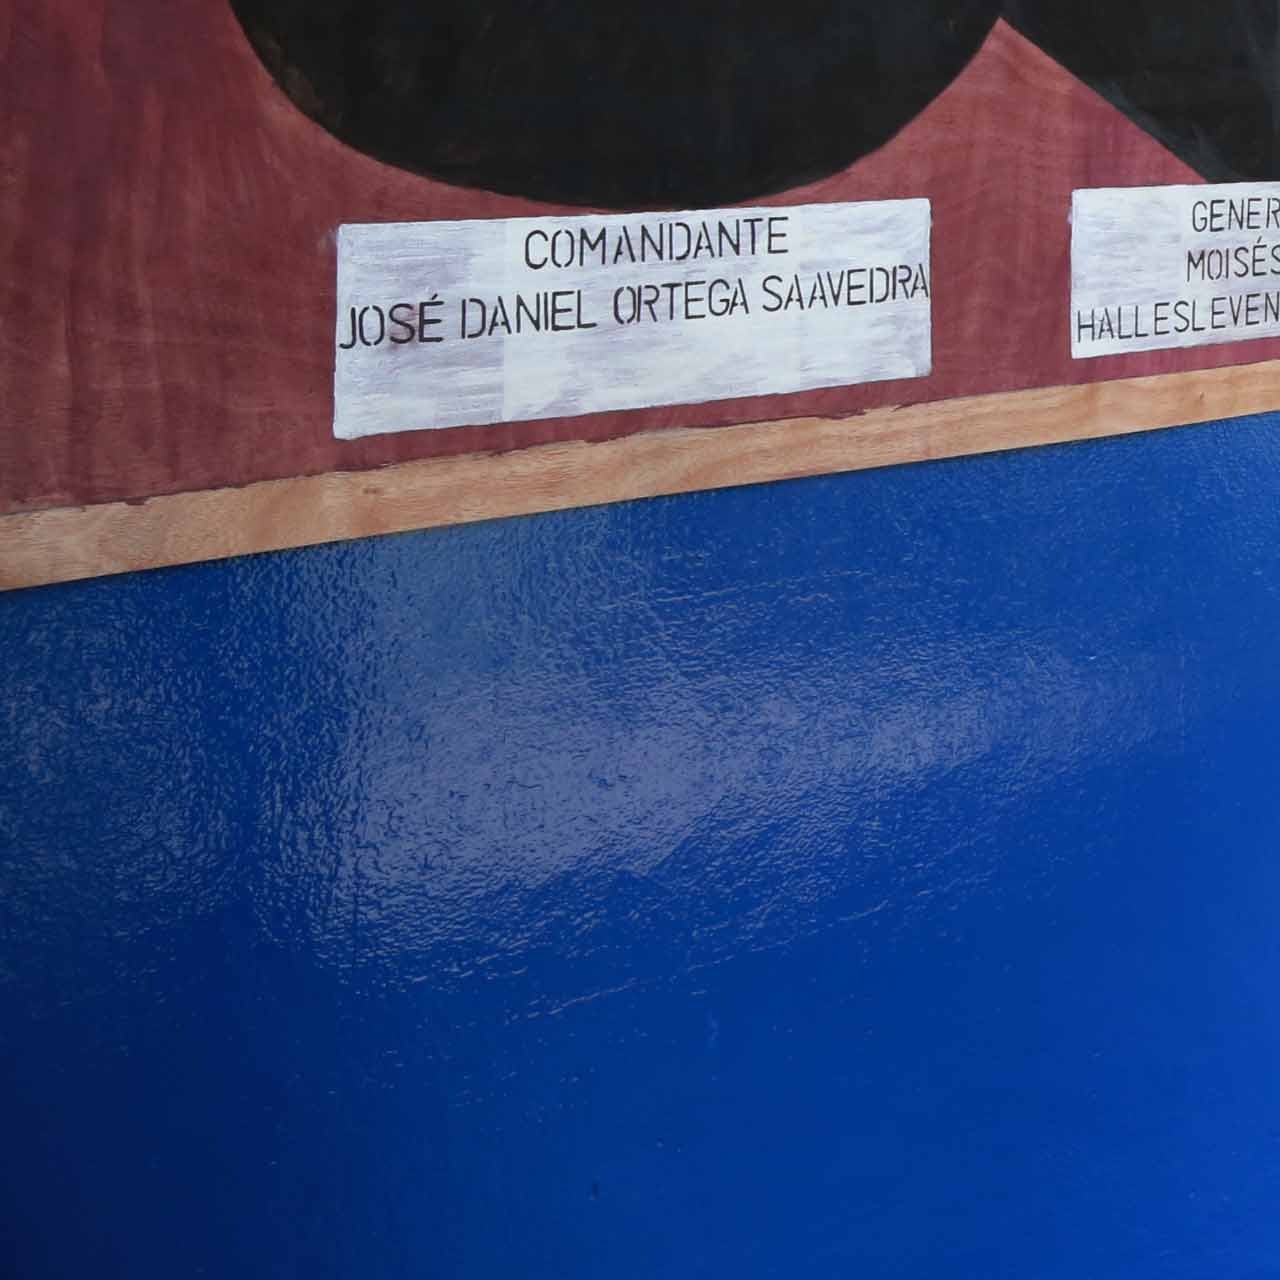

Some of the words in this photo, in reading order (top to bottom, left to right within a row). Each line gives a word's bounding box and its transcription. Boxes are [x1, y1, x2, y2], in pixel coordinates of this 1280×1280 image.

[524, 216, 790, 271] COMANDANTE
[339, 294, 445, 350] JOSÉ
[460, 290, 599, 340] DANIEL
[612, 277, 751, 326] ORTEGA
[761, 263, 930, 313] SAAVEDRA
